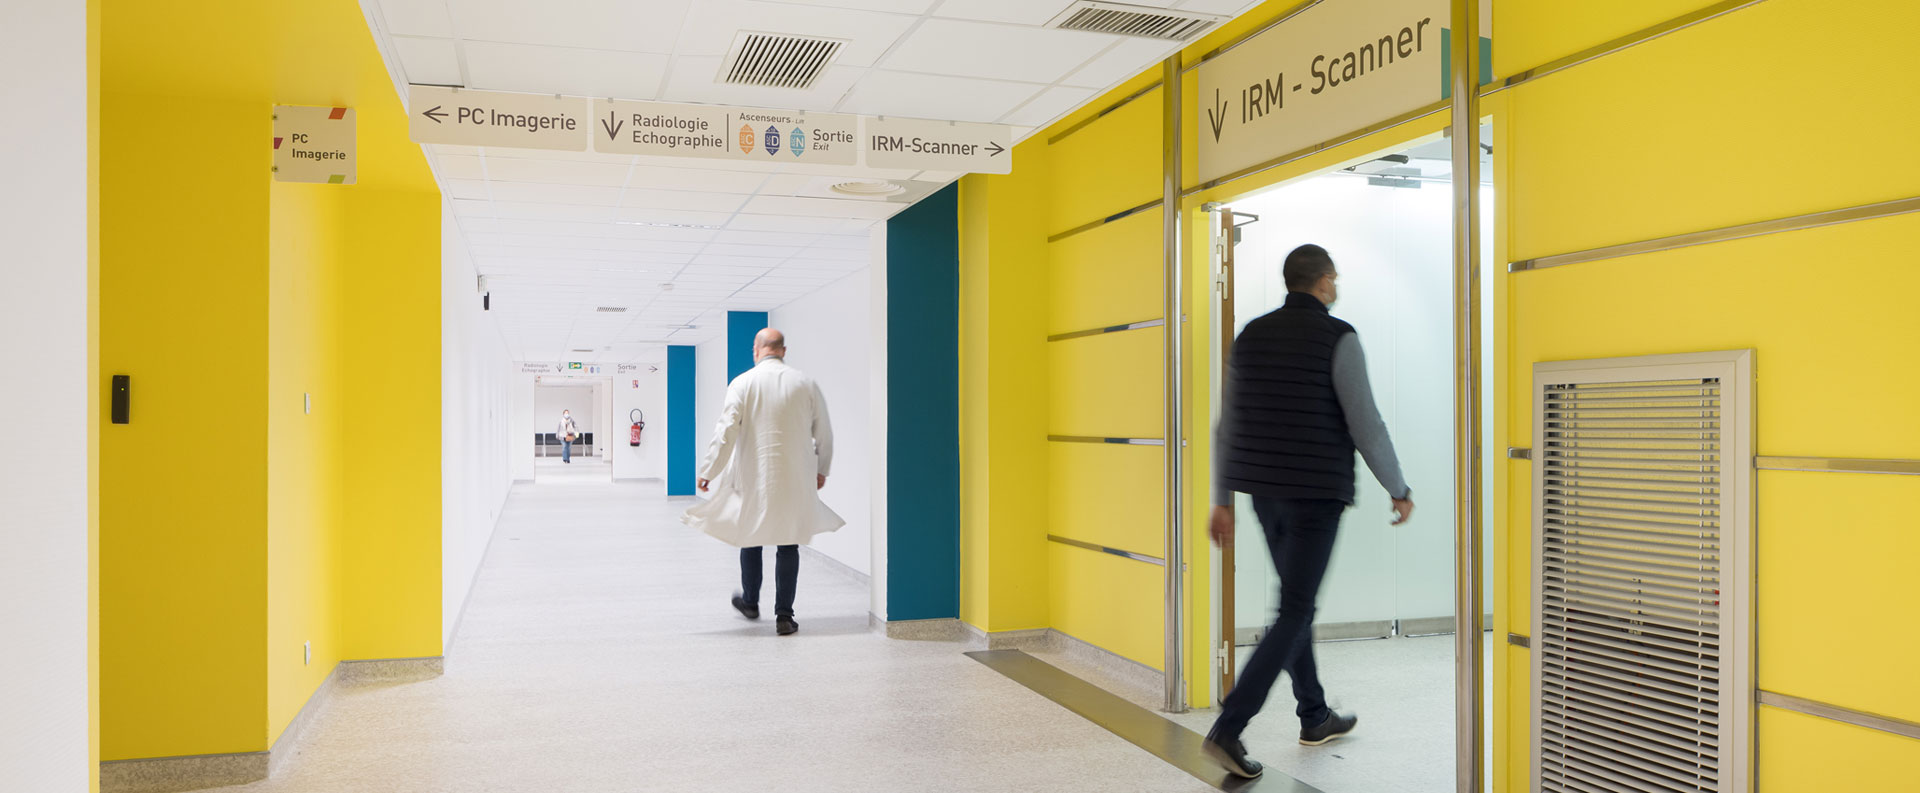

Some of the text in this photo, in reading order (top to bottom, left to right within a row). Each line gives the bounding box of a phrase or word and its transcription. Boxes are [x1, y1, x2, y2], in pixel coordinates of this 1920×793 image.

[1242, 72, 1284, 124] IRM
[1310, 17, 1431, 95] Scanner
[457, 106, 577, 132] PC Imagerie
[632, 113, 709, 133] Radiologie
[739, 112, 791, 123] Ascenseurs
[291, 133, 309, 144] PC
[632, 130, 723, 149] Echographie
[745, 134, 753, 145] C
[771, 135, 779, 147] D
[796, 136, 804, 148] N
[813, 128, 853, 143] Sortie
[812, 142, 830, 151] Exit
[872, 135, 979, 156] IRM-Scanner
[291, 148, 347, 162] Imagerie
[617, 363, 637, 371] Sortie
